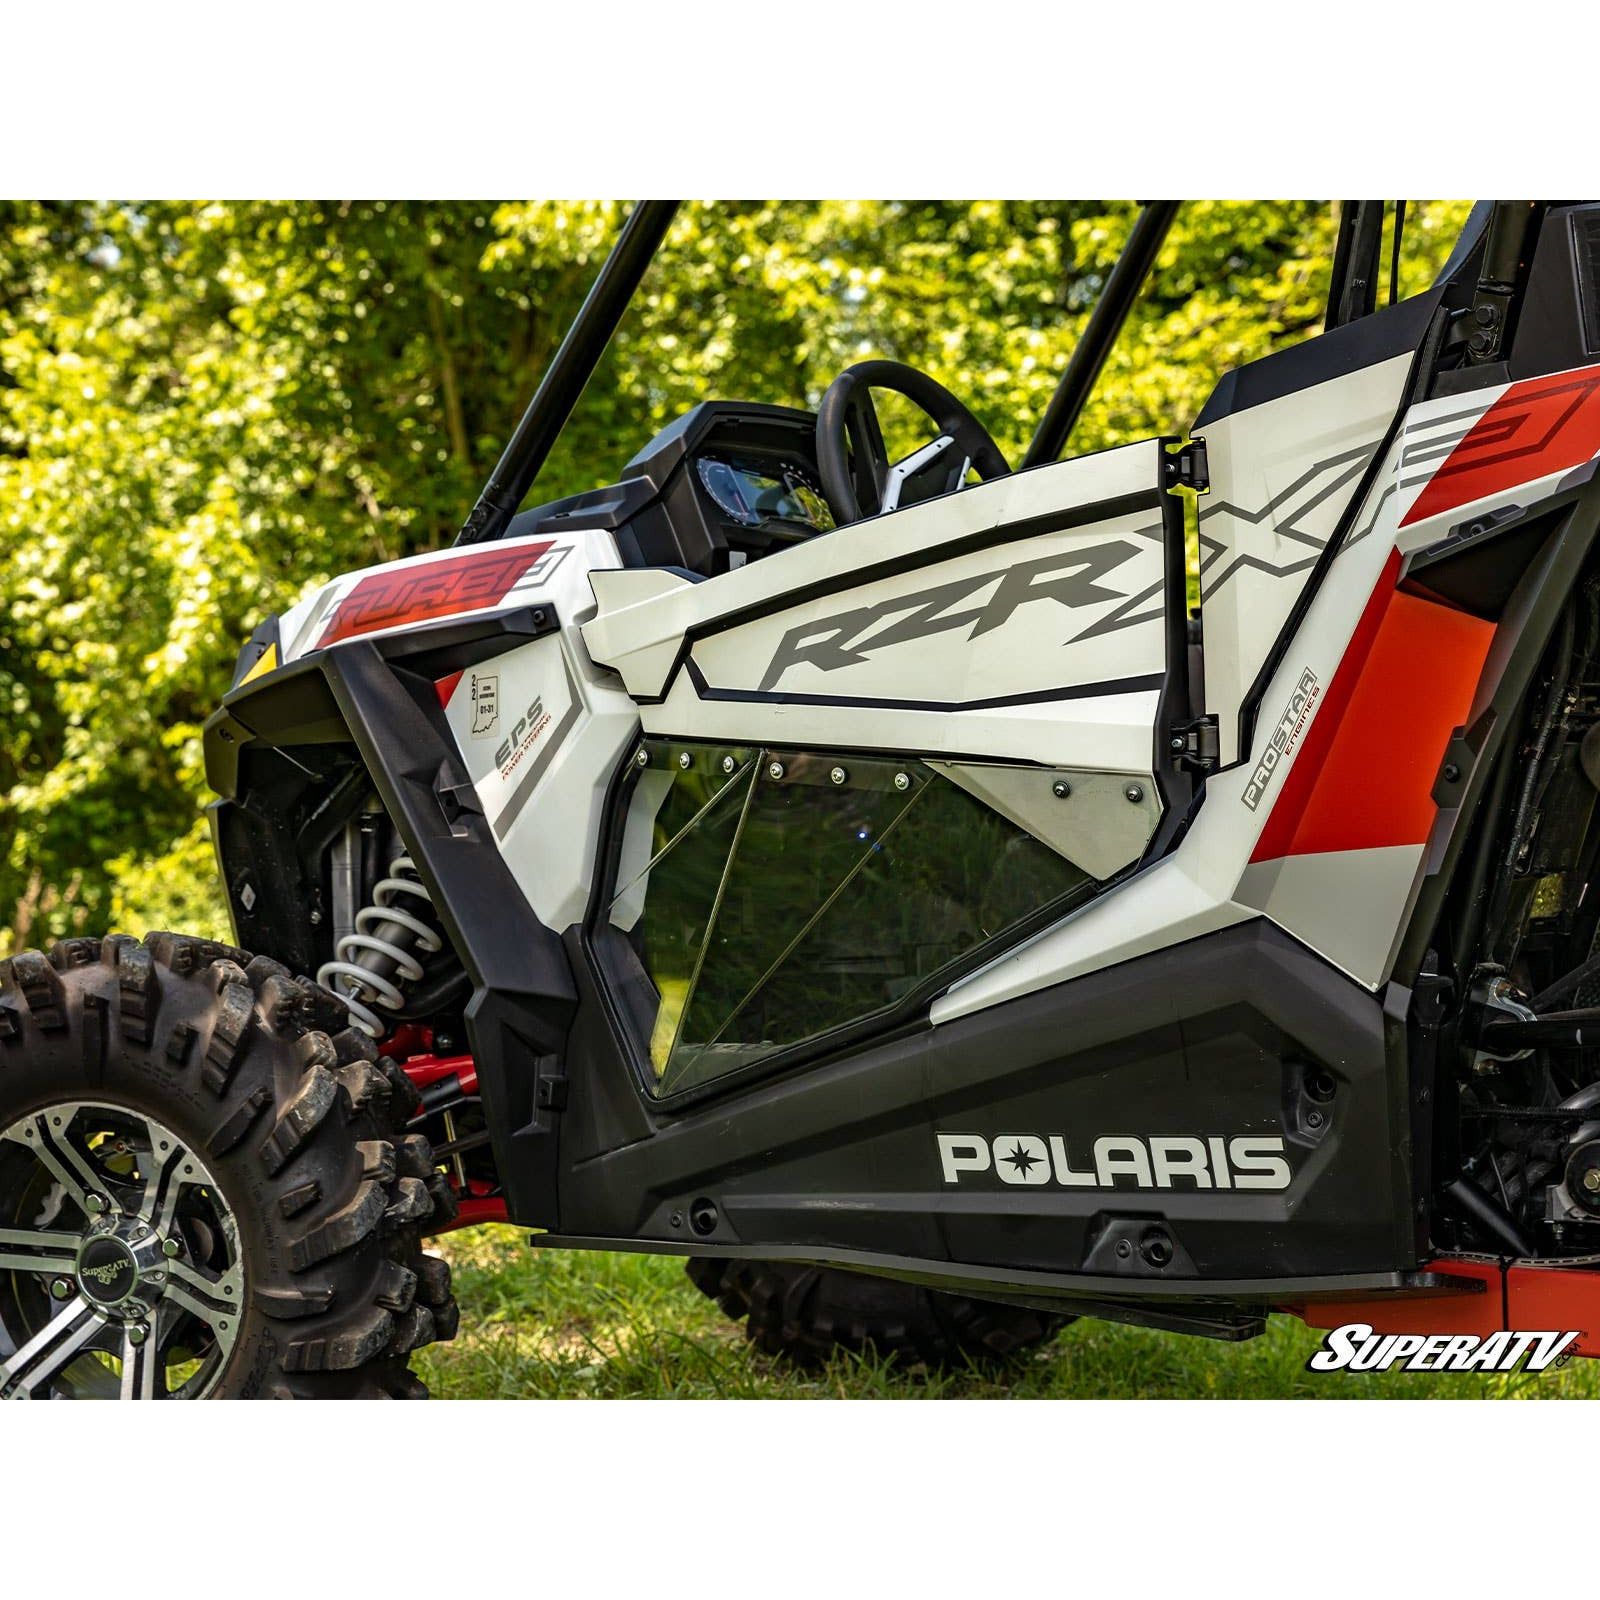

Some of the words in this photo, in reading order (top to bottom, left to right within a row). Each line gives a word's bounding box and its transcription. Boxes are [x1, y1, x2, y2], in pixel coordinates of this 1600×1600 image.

[319, 545, 575, 635] TURBO
[758, 539, 1143, 692] RZR
[495, 695, 543, 770] EPS
[1243, 669, 1316, 809] PROSTAR
[937, 1135, 1293, 1188] POLARIS
